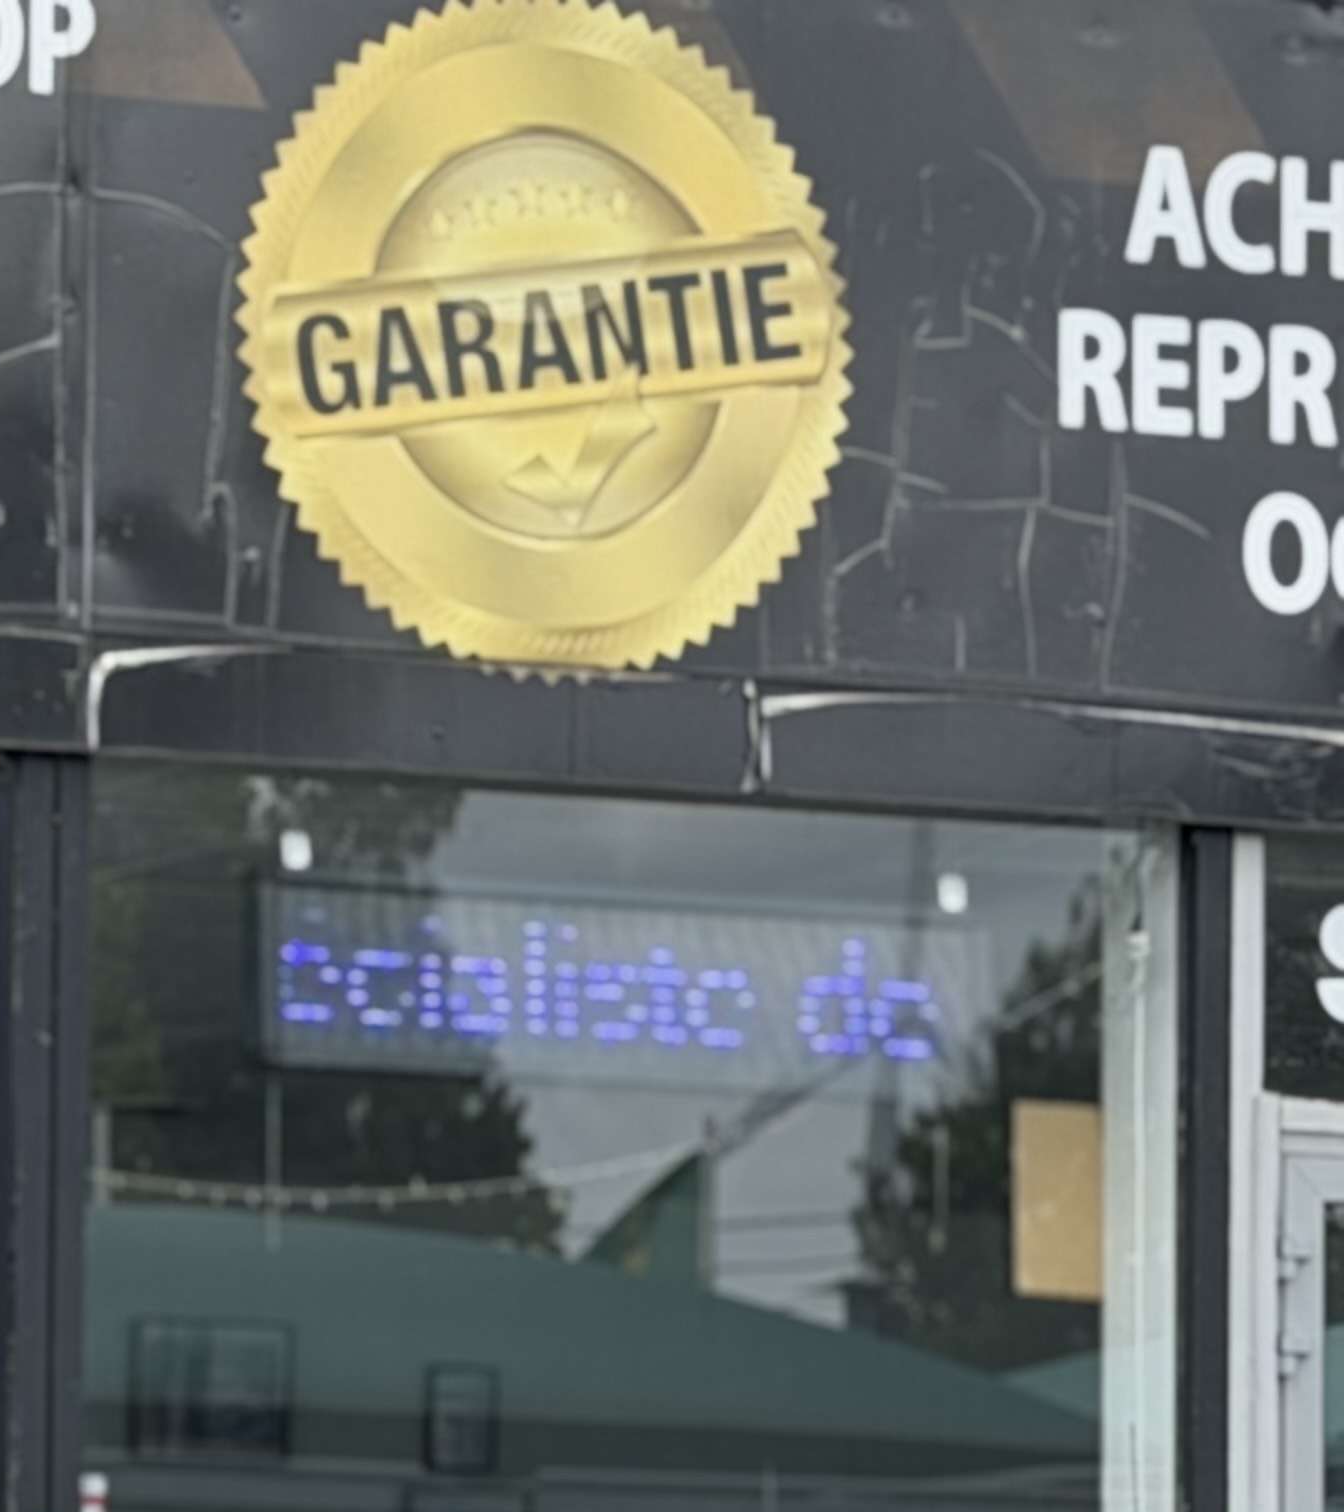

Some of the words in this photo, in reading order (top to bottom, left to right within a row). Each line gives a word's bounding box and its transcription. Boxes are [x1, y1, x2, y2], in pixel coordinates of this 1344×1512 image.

[1124, 145, 1344, 280] ACH
[296, 262, 802, 415] GARANTIE
[1057, 307, 1339, 448] REPR
[1242, 490, 1344, 616] O
